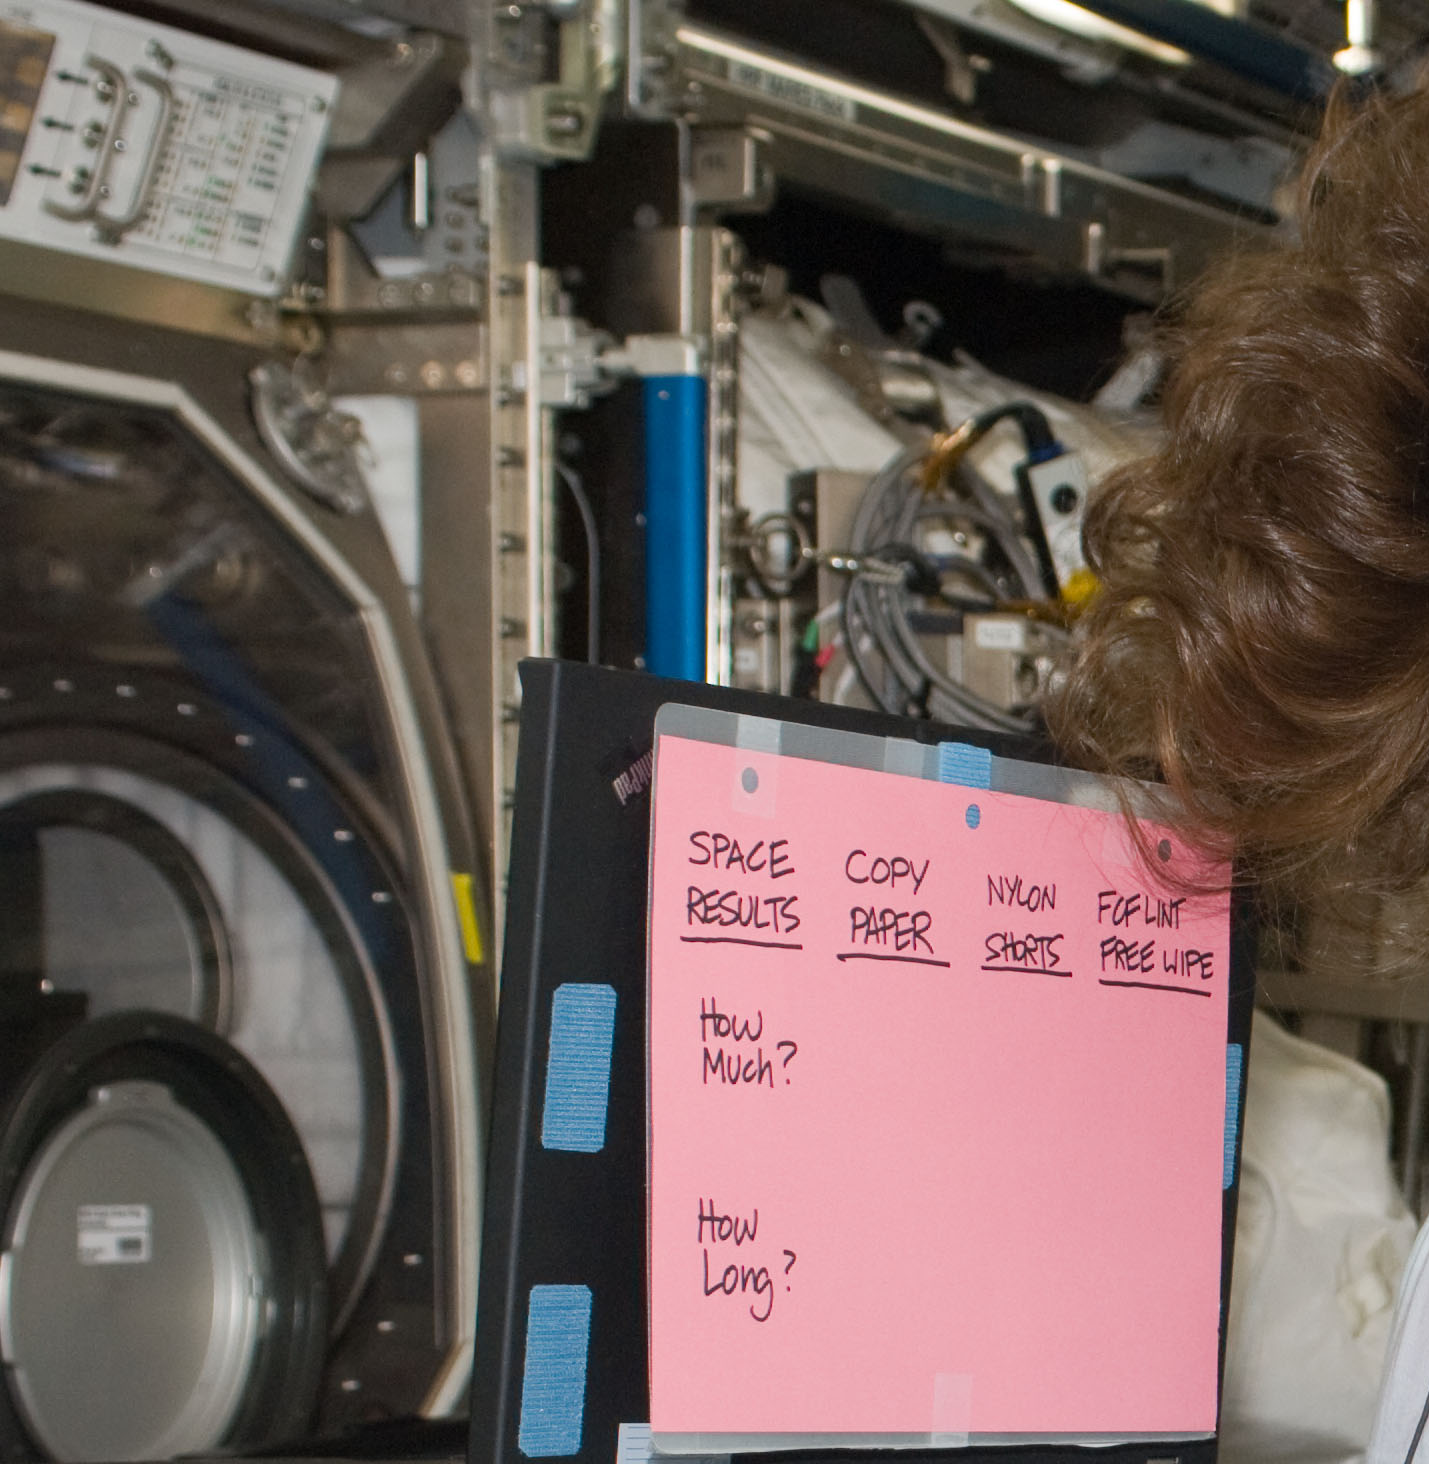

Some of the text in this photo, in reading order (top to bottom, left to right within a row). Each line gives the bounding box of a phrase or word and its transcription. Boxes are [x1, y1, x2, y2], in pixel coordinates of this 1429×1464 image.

[689, 831, 794, 878] SPACE
[846, 850, 929, 894] COPY
[687, 886, 800, 933] RESULTS
[988, 875, 1055, 912] NYLON
[1145, 898, 1185, 929] LINT
[851, 907, 933, 951] PAPER
[986, 933, 1064, 966] SHORTS
[1100, 936, 1213, 979] FREE WIPE
[701, 998, 762, 1040] How
[704, 1041, 797, 1087] Much?
[699, 1199, 757, 1245] How
[704, 1250, 796, 1322] Long?
